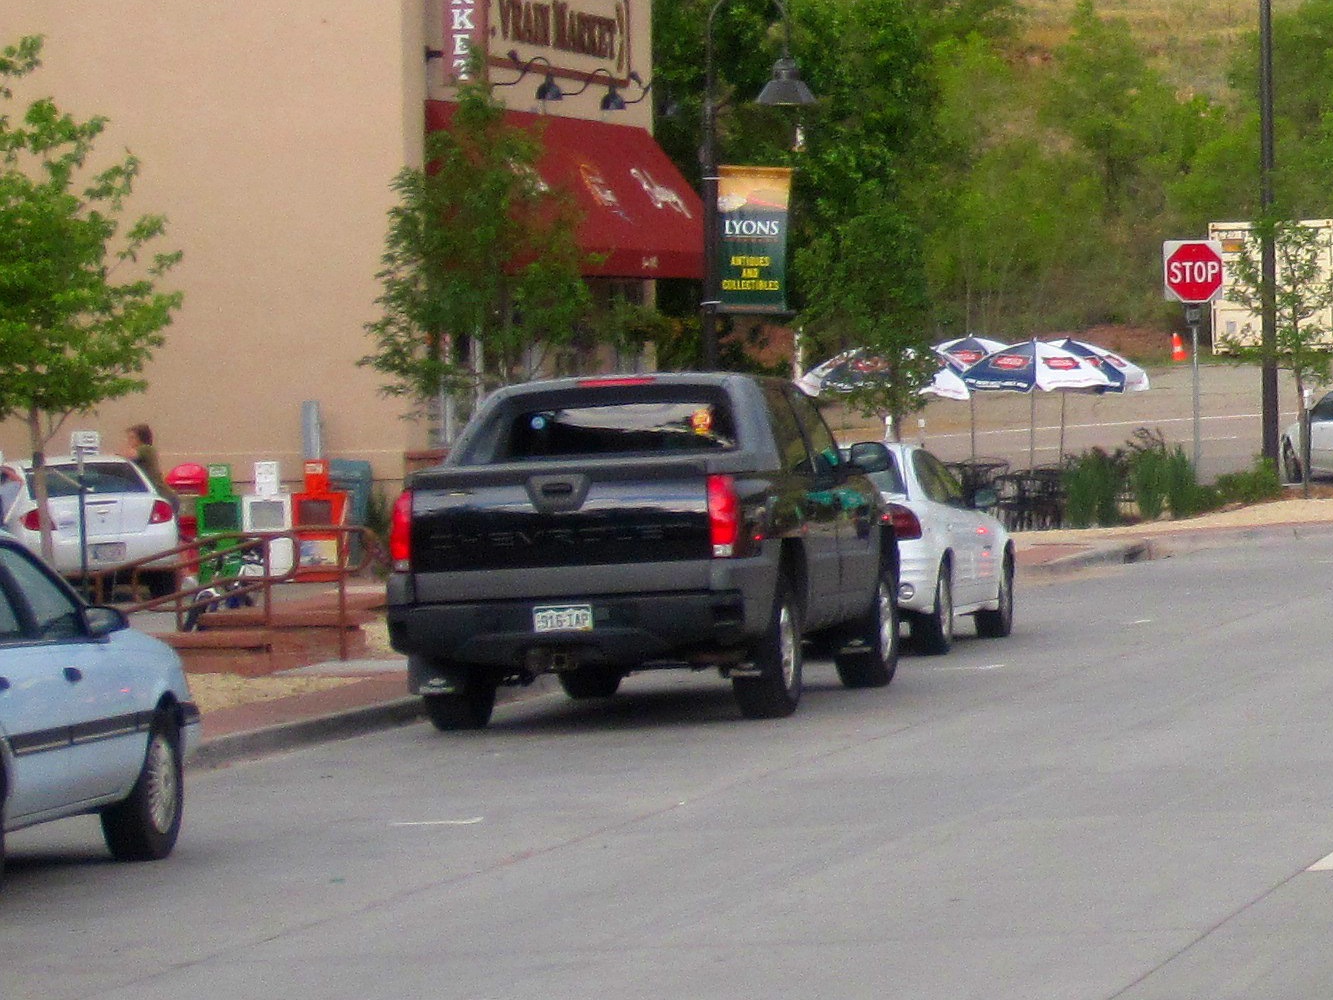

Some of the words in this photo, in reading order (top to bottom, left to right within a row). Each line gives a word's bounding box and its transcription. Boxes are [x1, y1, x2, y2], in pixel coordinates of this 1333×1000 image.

[552, 0, 616, 60] MARKET
[724, 220, 779, 235] LYONS
[741, 268, 759, 279] AND
[1169, 261, 1219, 284] STOP
[721, 280, 780, 291] COLLECTIBLES
